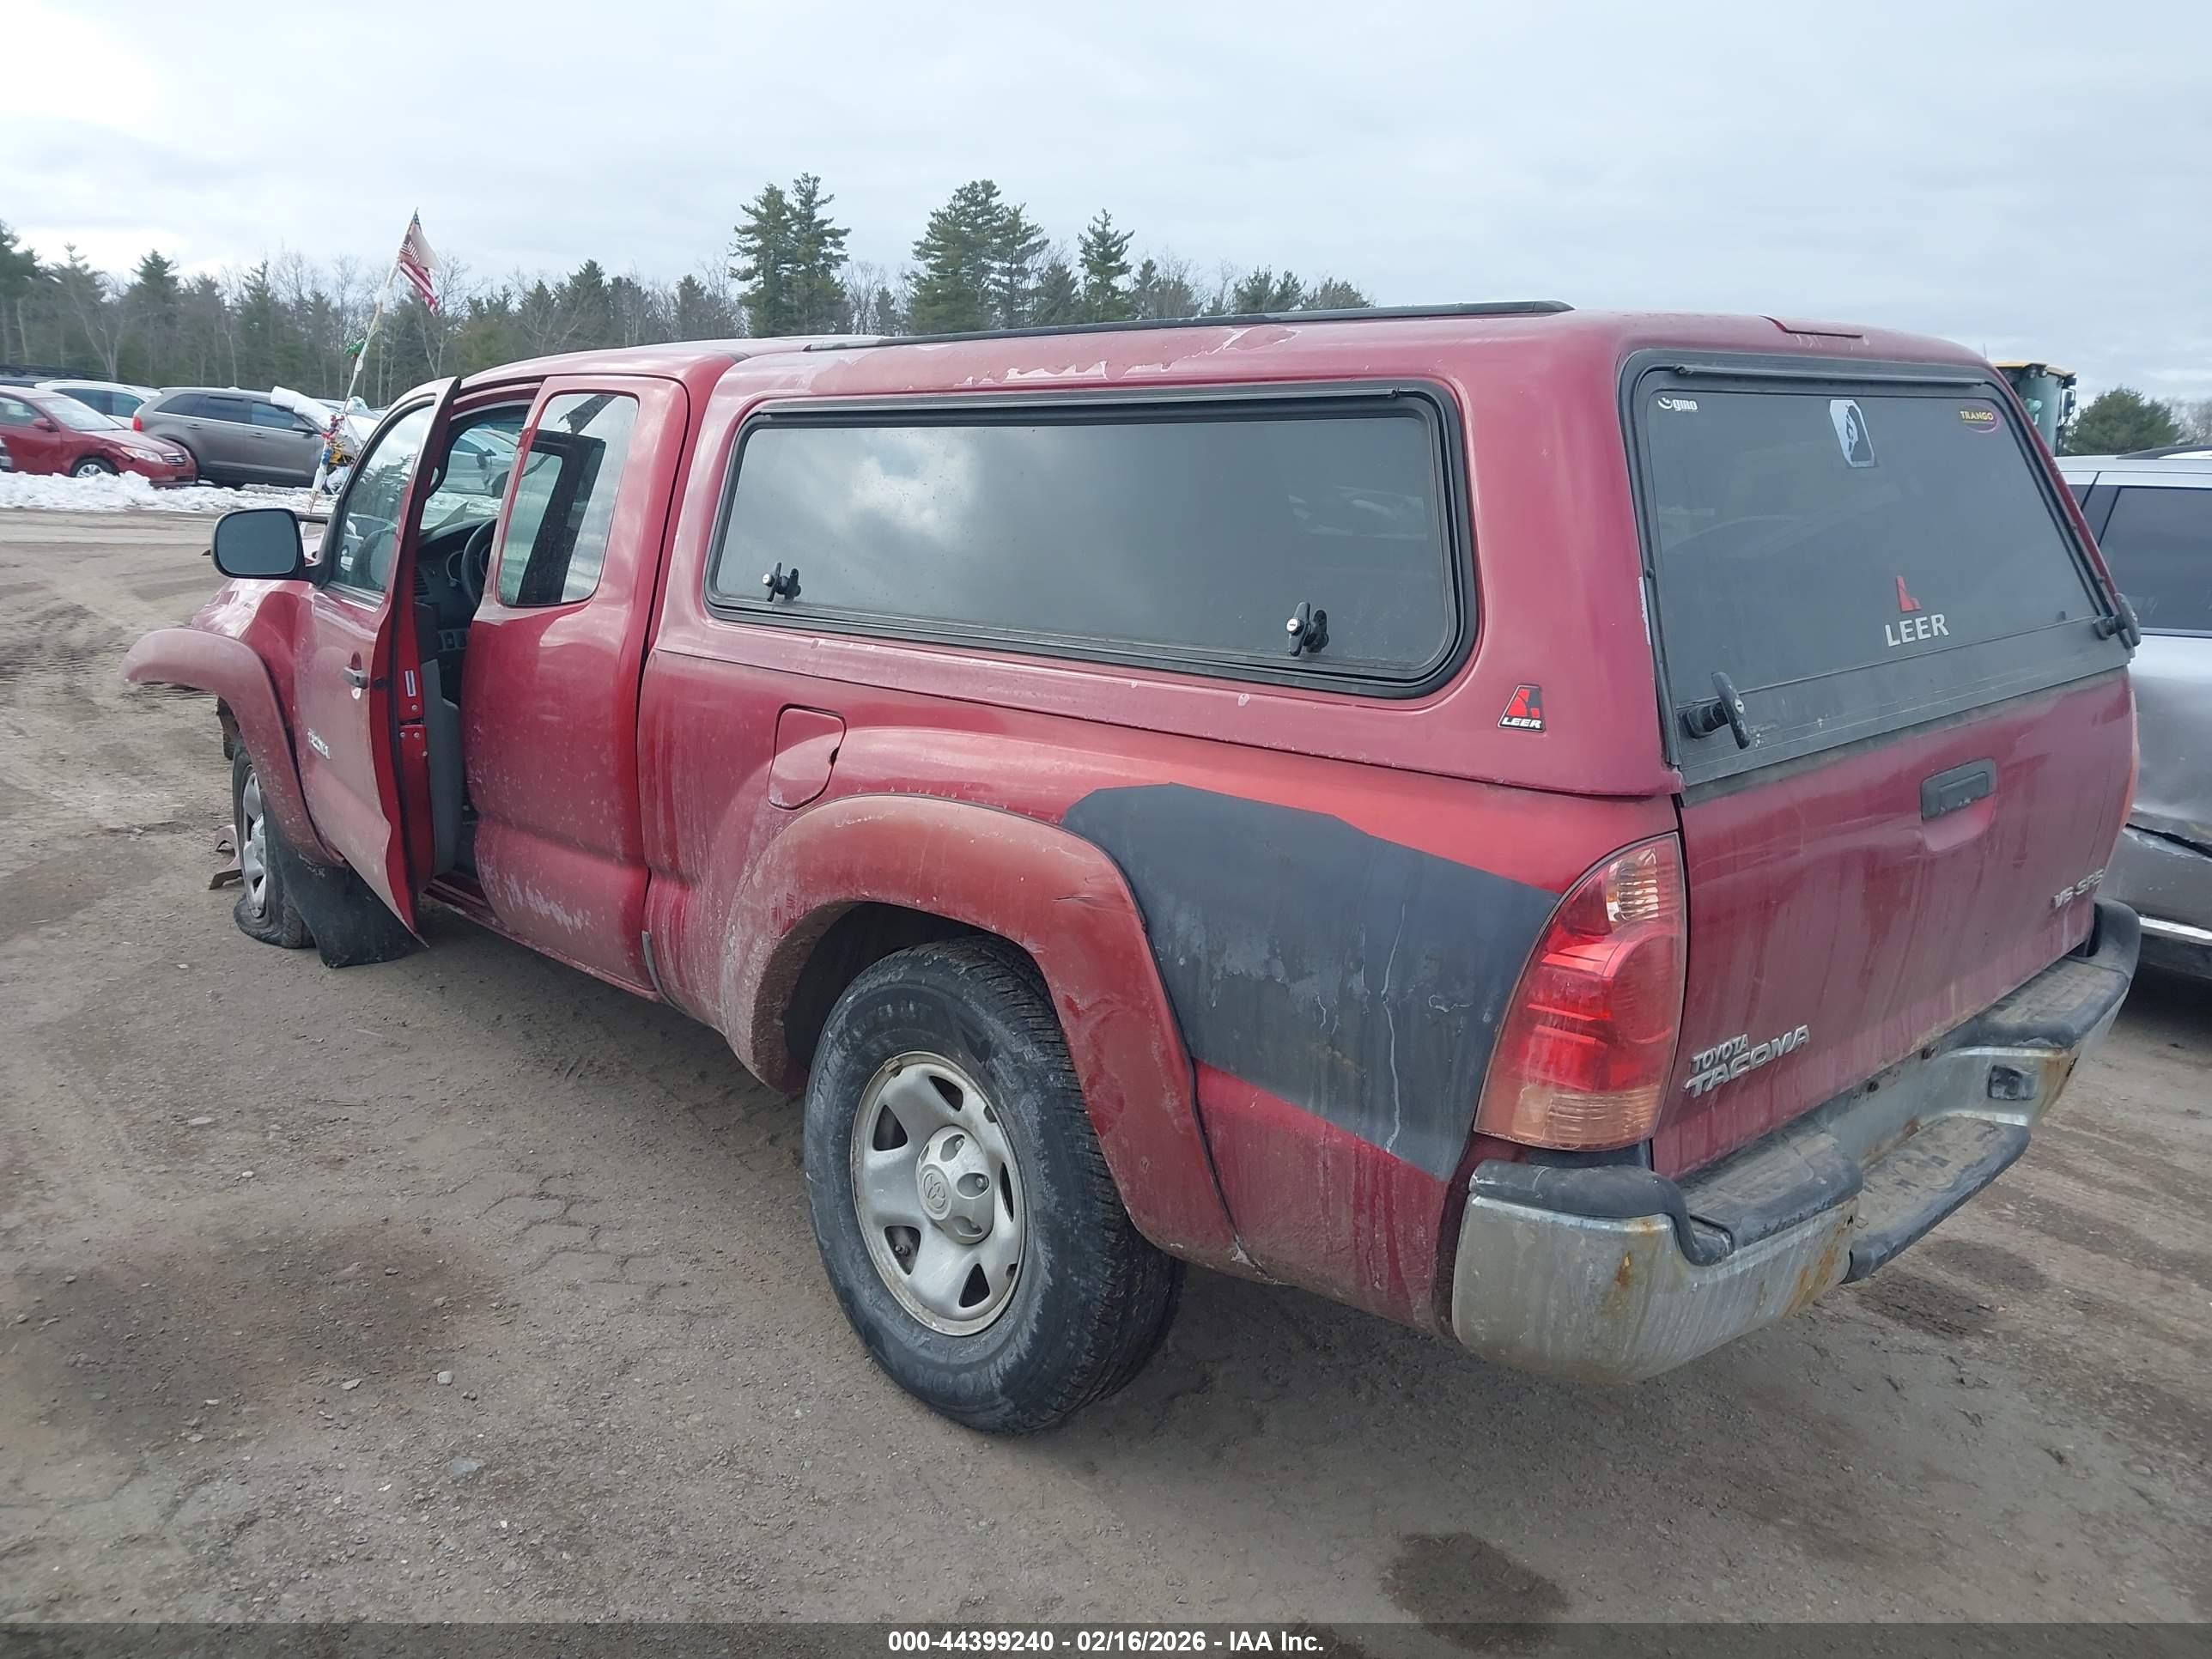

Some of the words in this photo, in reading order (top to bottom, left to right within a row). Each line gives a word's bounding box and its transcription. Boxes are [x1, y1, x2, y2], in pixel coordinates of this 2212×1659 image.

[1960, 410, 1994, 421] TRANGO
[1885, 613, 1949, 647] LEER
[1501, 716, 1542, 729] LEER
[1683, 1024, 1810, 1098] TACOMA
[1691, 1033, 1749, 1073] TOYOTA
